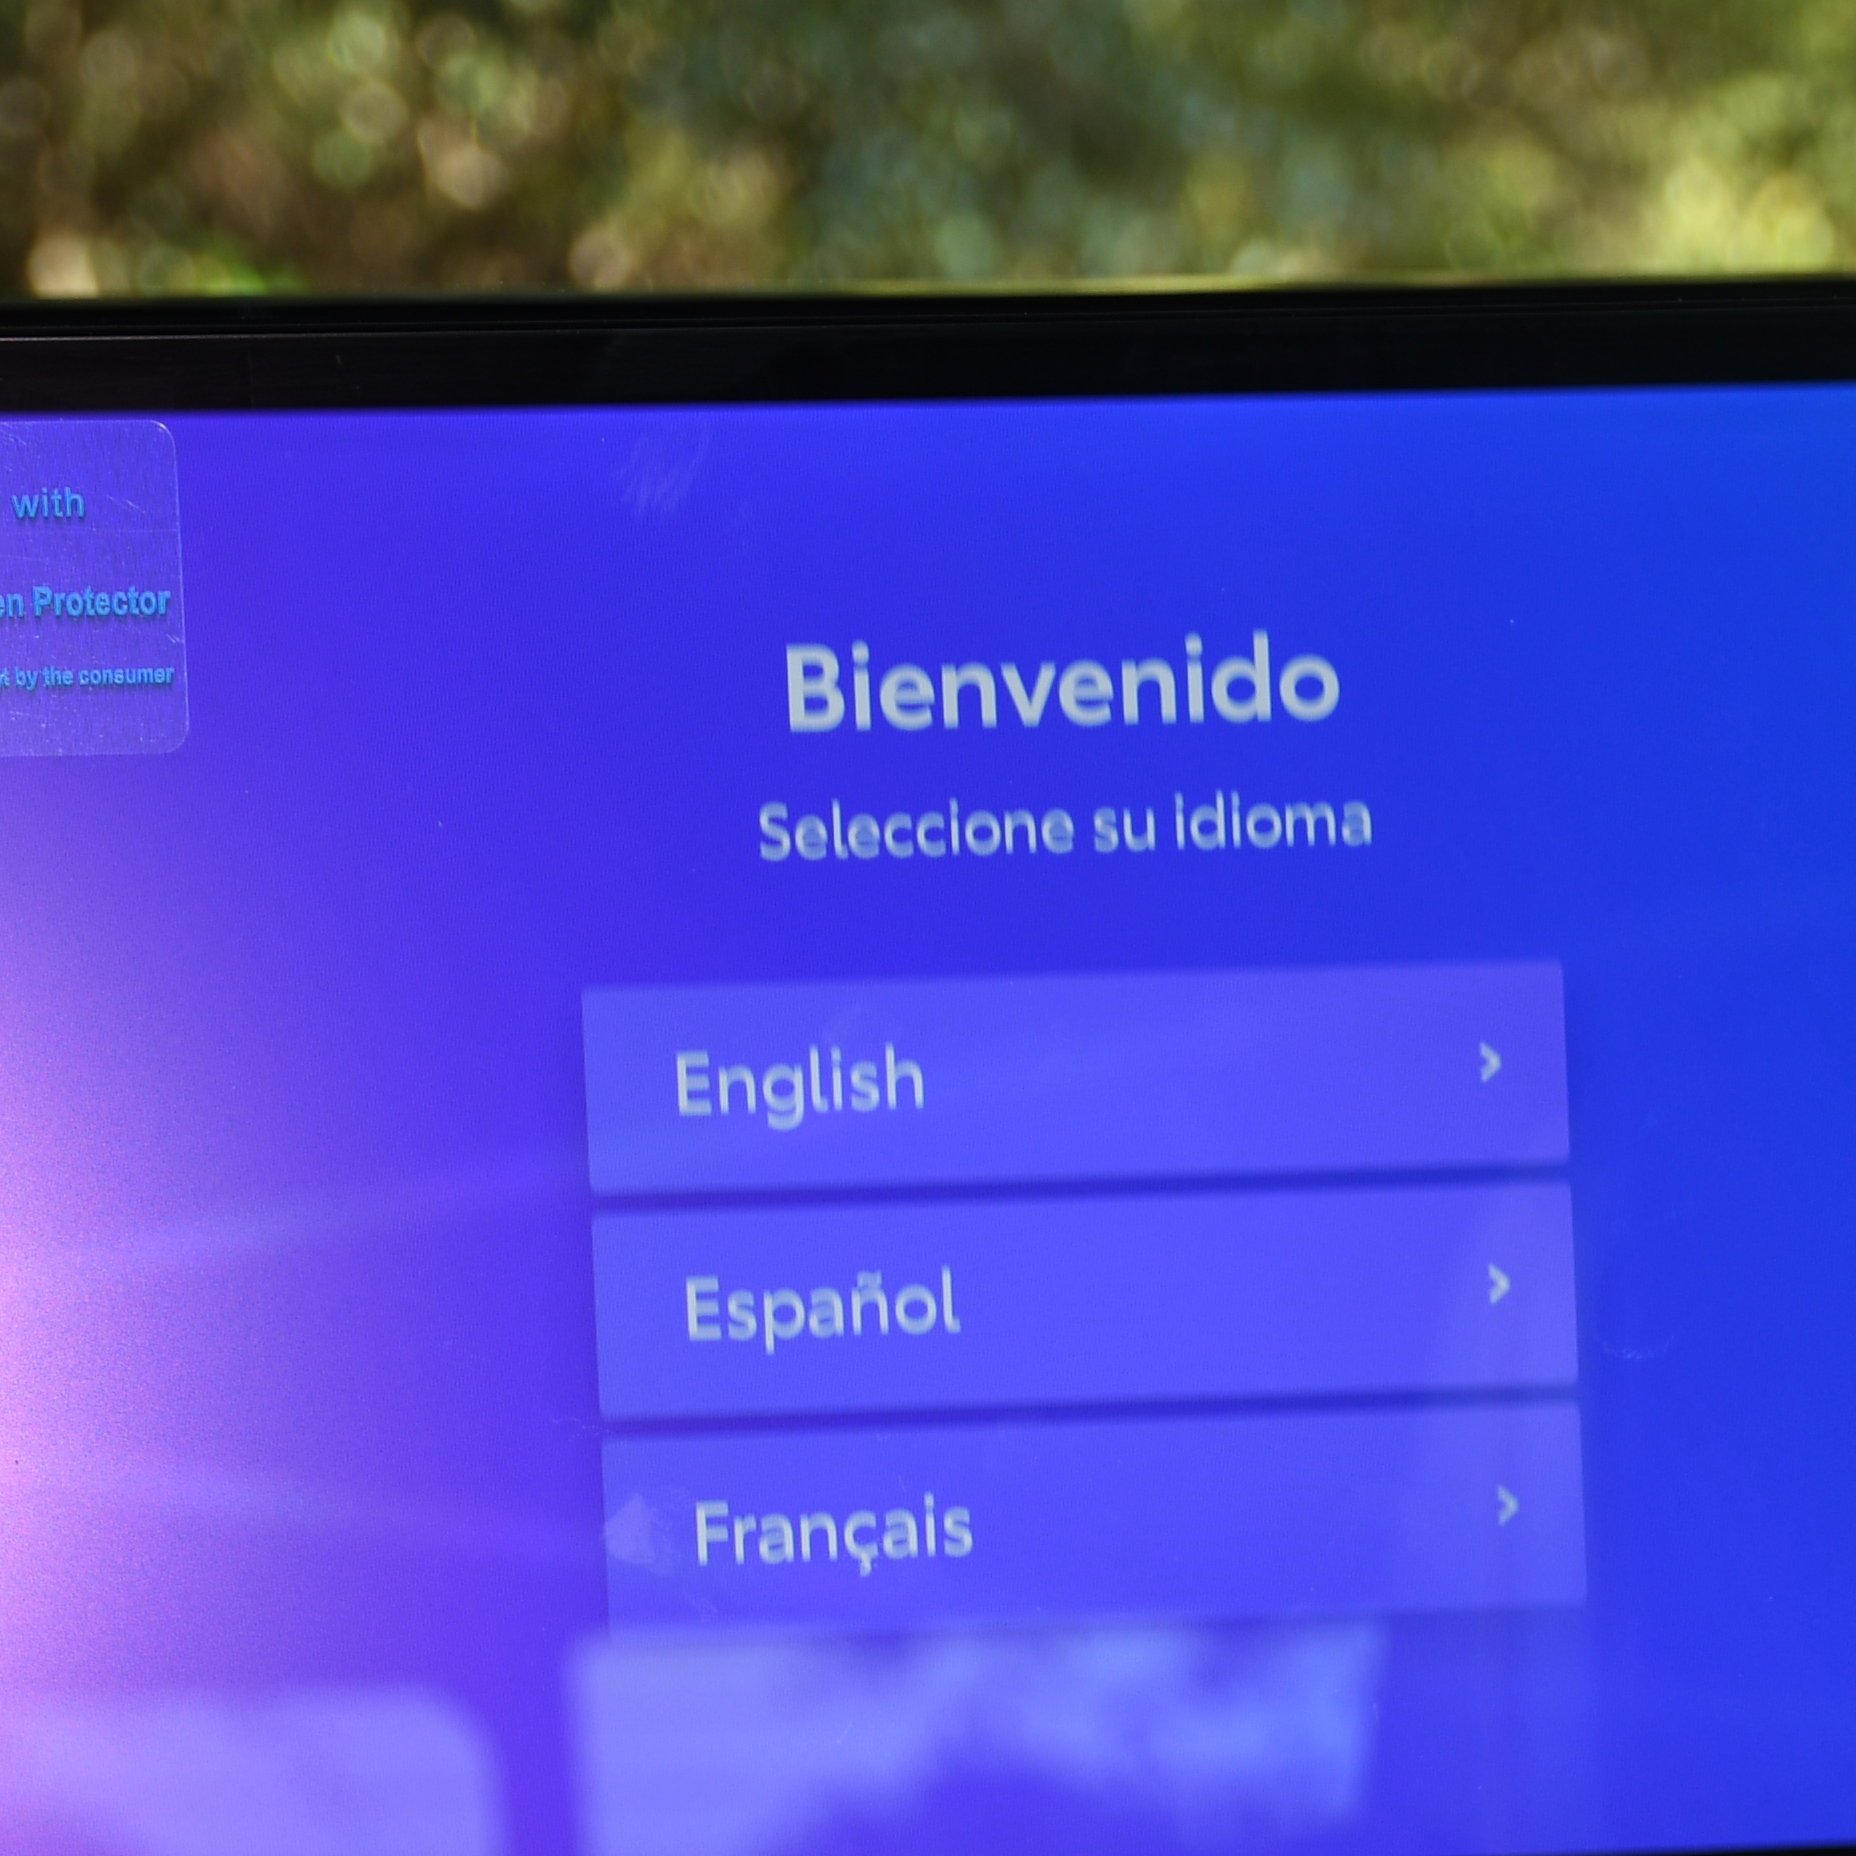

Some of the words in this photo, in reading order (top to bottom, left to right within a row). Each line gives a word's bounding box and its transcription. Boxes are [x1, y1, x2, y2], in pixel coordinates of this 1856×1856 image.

[12, 487, 85, 520] with
[33, 585, 172, 618] Protector
[14, 666, 38, 691] by
[44, 664, 74, 687] the
[79, 666, 175, 687] consumer
[784, 629, 1342, 733] Bienvenido
[758, 797, 1075, 862] Seleccione
[1093, 806, 1157, 852] su
[1175, 789, 1373, 851] idioma
[674, 1042, 925, 1131] English
[685, 1266, 962, 1354] Español
[694, 1493, 973, 1575] Français
